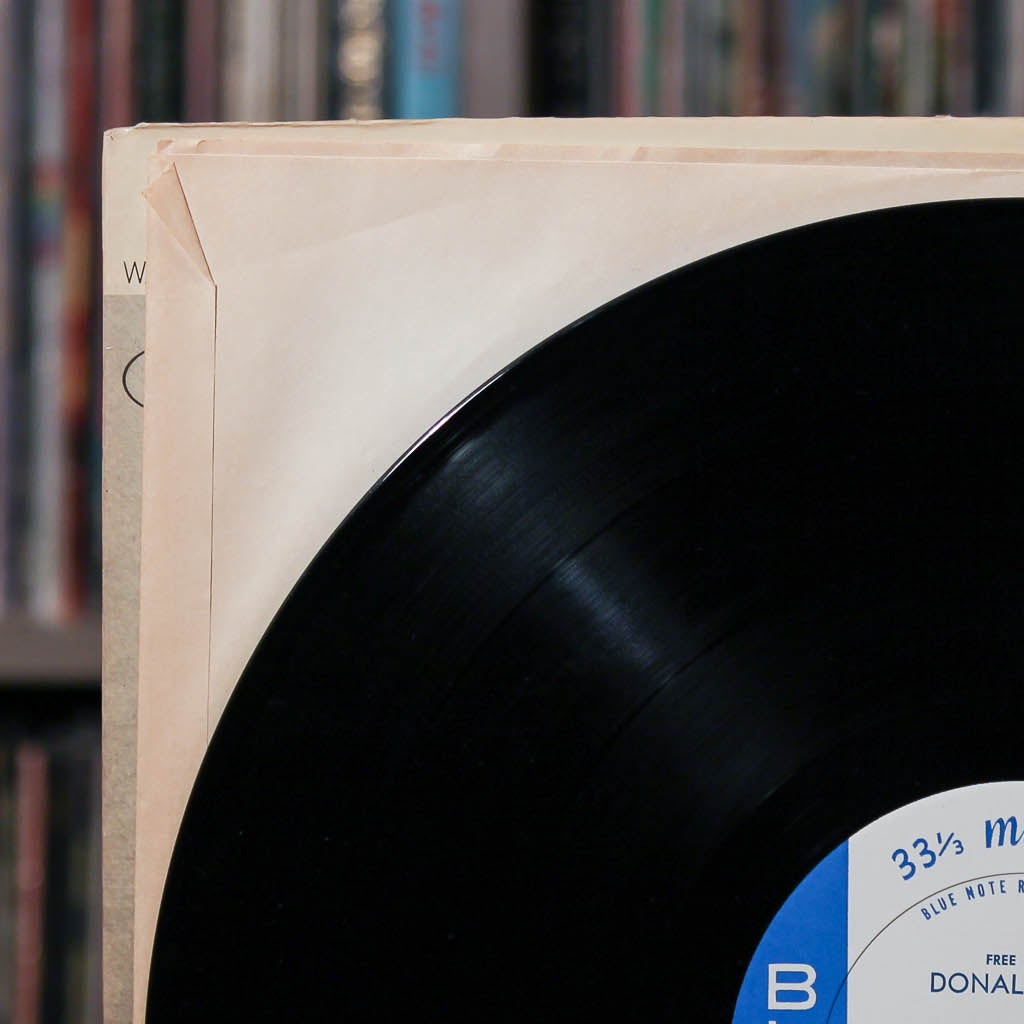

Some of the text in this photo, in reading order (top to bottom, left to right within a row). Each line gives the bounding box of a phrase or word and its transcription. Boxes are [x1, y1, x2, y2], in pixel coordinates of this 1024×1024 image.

[920, 892, 957, 921] BLUE
[965, 879, 1006, 900] NOTE
[986, 953, 1016, 966] FREE
